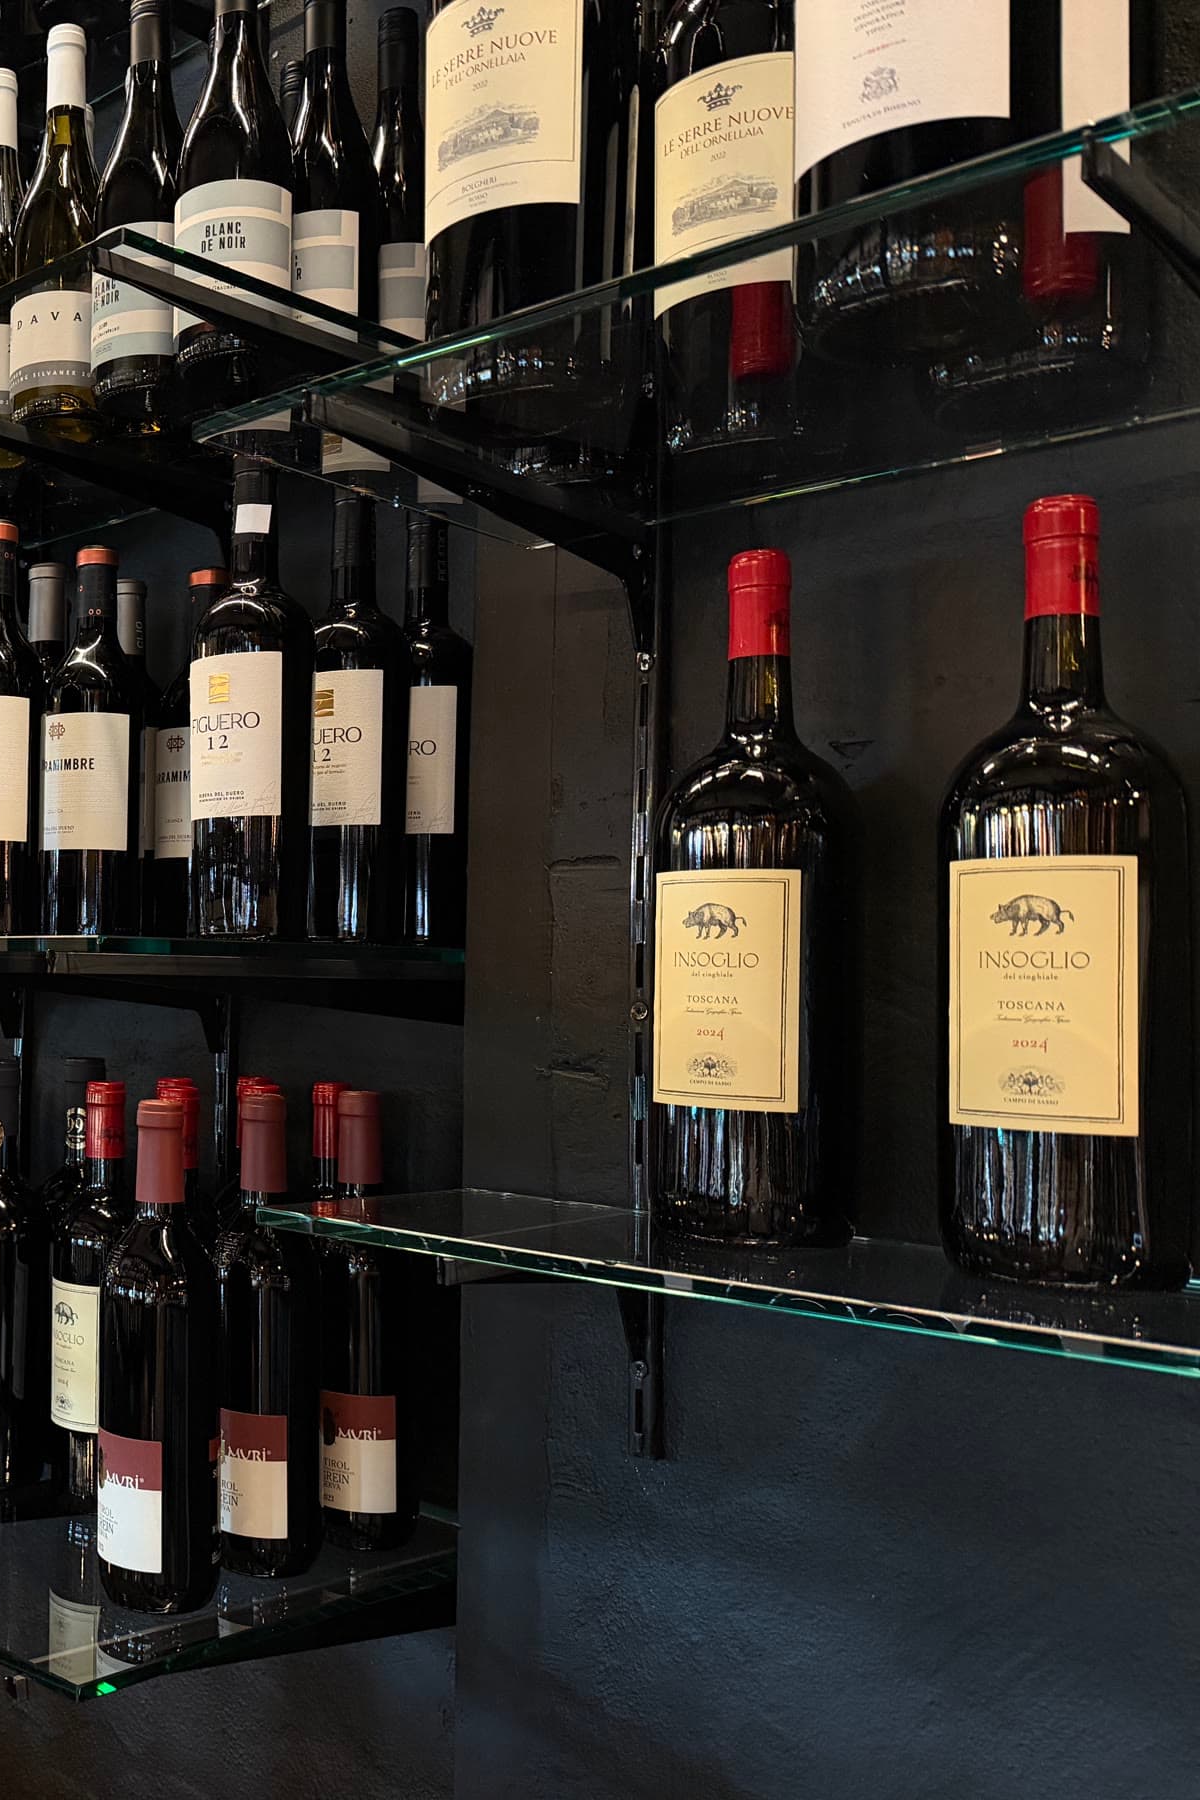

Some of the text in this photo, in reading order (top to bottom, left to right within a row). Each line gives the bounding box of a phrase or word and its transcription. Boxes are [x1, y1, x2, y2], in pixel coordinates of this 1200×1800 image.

[431, 29, 558, 89] LE SERRE NUOVE
[663, 105, 795, 158] LE SERRE NUOVE
[460, 175, 498, 194] BOLGHERI
[205, 221, 242, 239] BLANC
[200, 235, 247, 254] DE NOIR
[100, 289, 120, 308] NOIR
[32, 369, 76, 379] SILVANER
[192, 710, 261, 736] FIGUERO
[225, 789, 245, 798] DUERO
[673, 950, 760, 969] INSOGLIO
[978, 950, 1091, 970] INSOGLIO
[1003, 972, 1059, 982] del cinghiale
[686, 994, 739, 1005] TOSCANA
[997, 1000, 1066, 1011] TOSCANA
[696, 1026, 725, 1041] 2024
[1011, 1037, 1049, 1054] 2024
